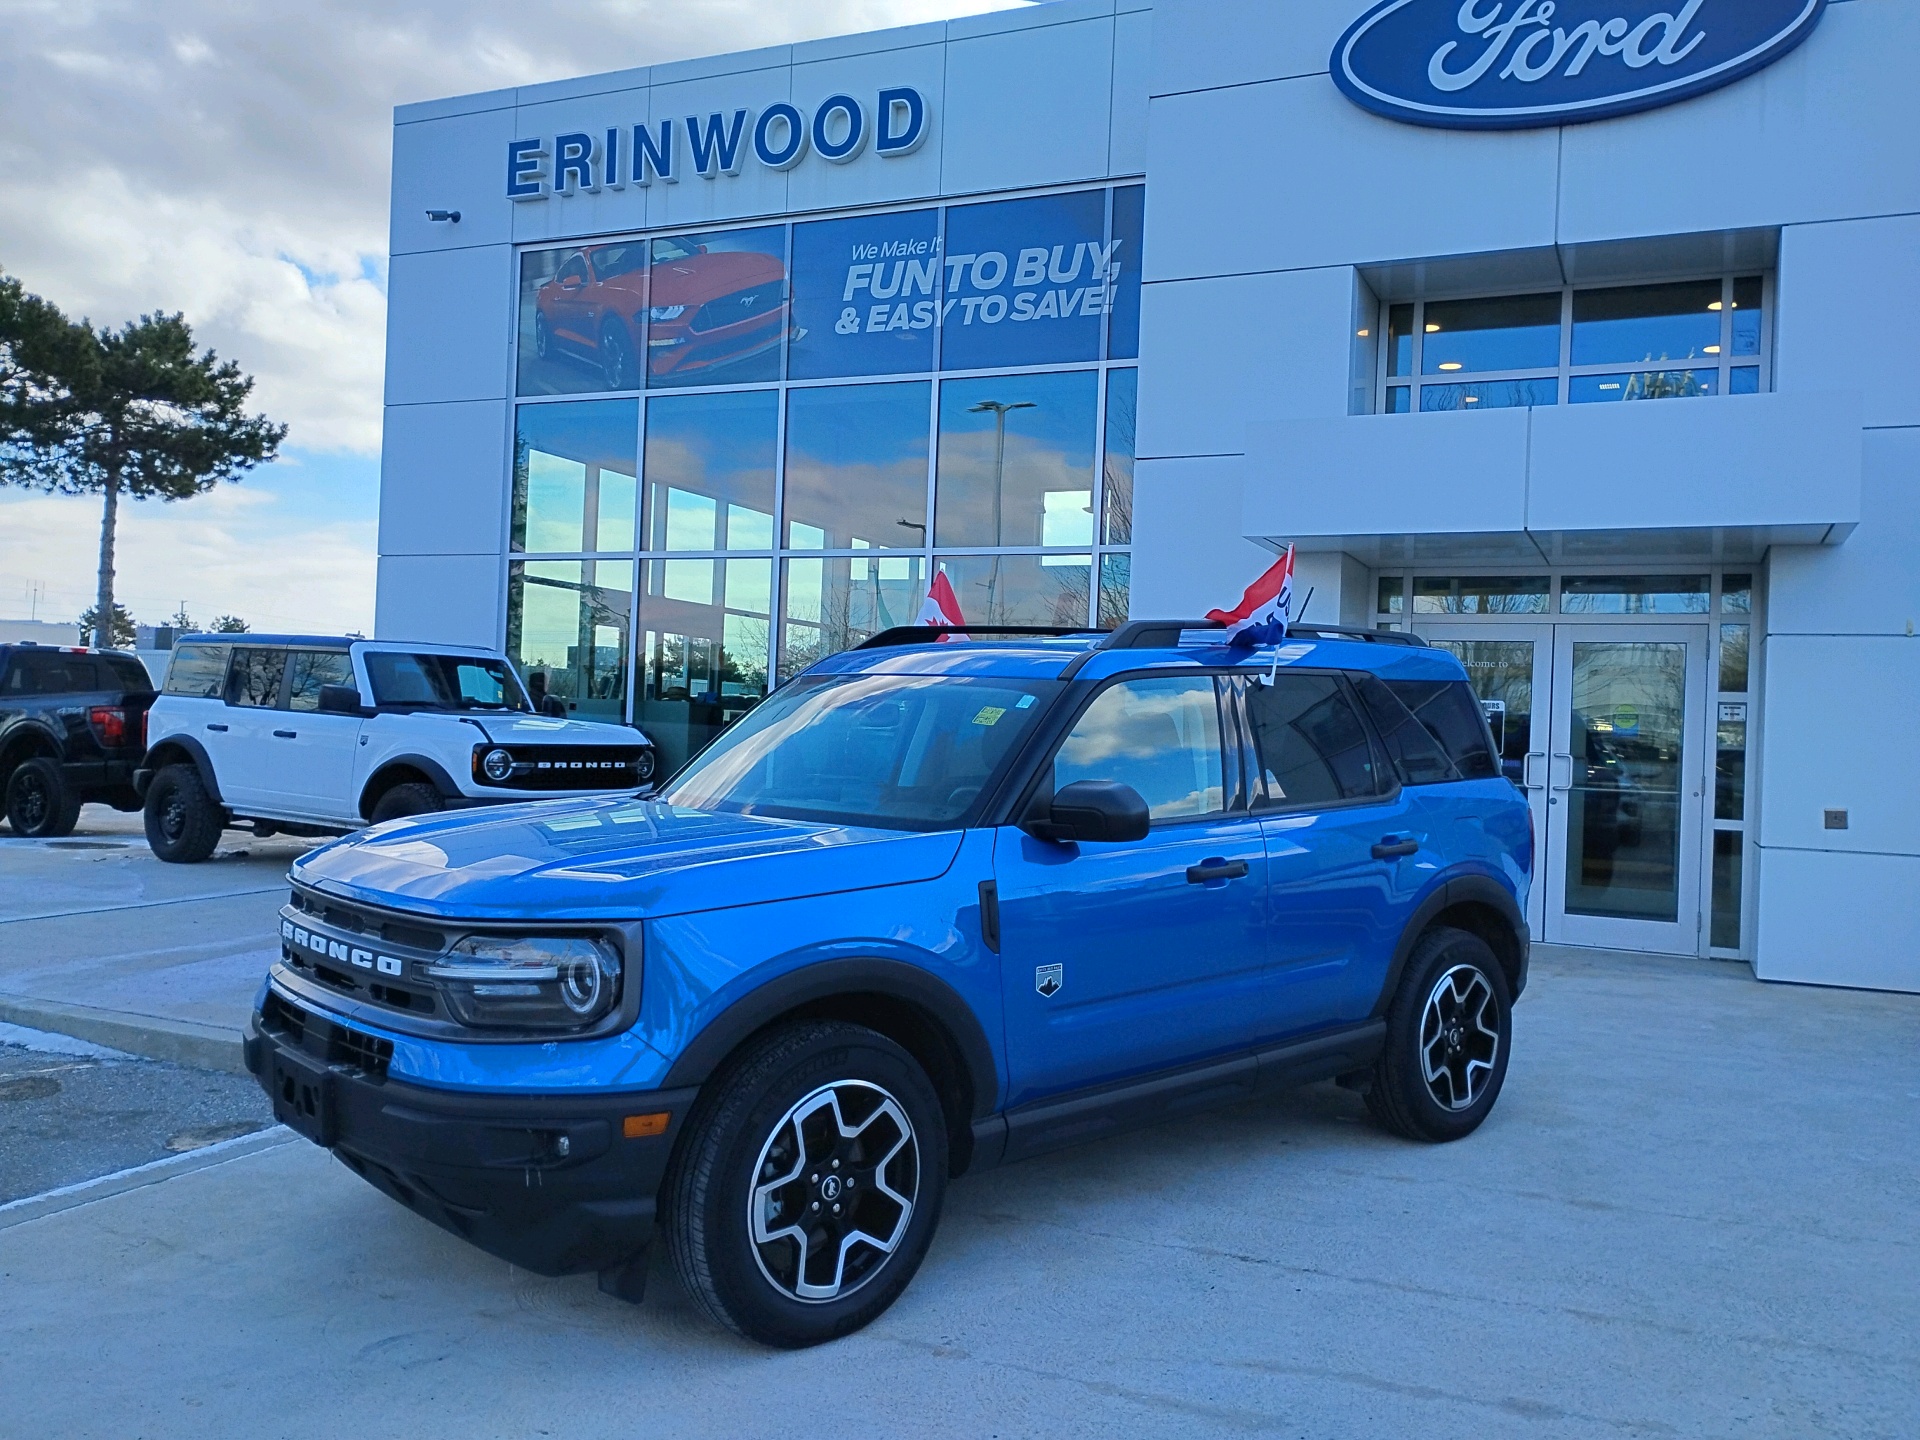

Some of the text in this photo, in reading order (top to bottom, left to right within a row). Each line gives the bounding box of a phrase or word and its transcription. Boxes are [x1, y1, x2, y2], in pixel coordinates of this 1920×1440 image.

[1428, 0, 1705, 91] Ford
[506, 86, 927, 201] ERINWOOD
[842, 239, 1122, 302] FUN TO BUY,
[852, 235, 943, 261] We Make It
[834, 284, 1118, 335] & EASY TO SAVE!
[1460, 658, 1509, 668] elcome to
[1482, 702, 1501, 710] OURS
[537, 761, 626, 769] BRONCO
[282, 920, 402, 976] BRONCO
